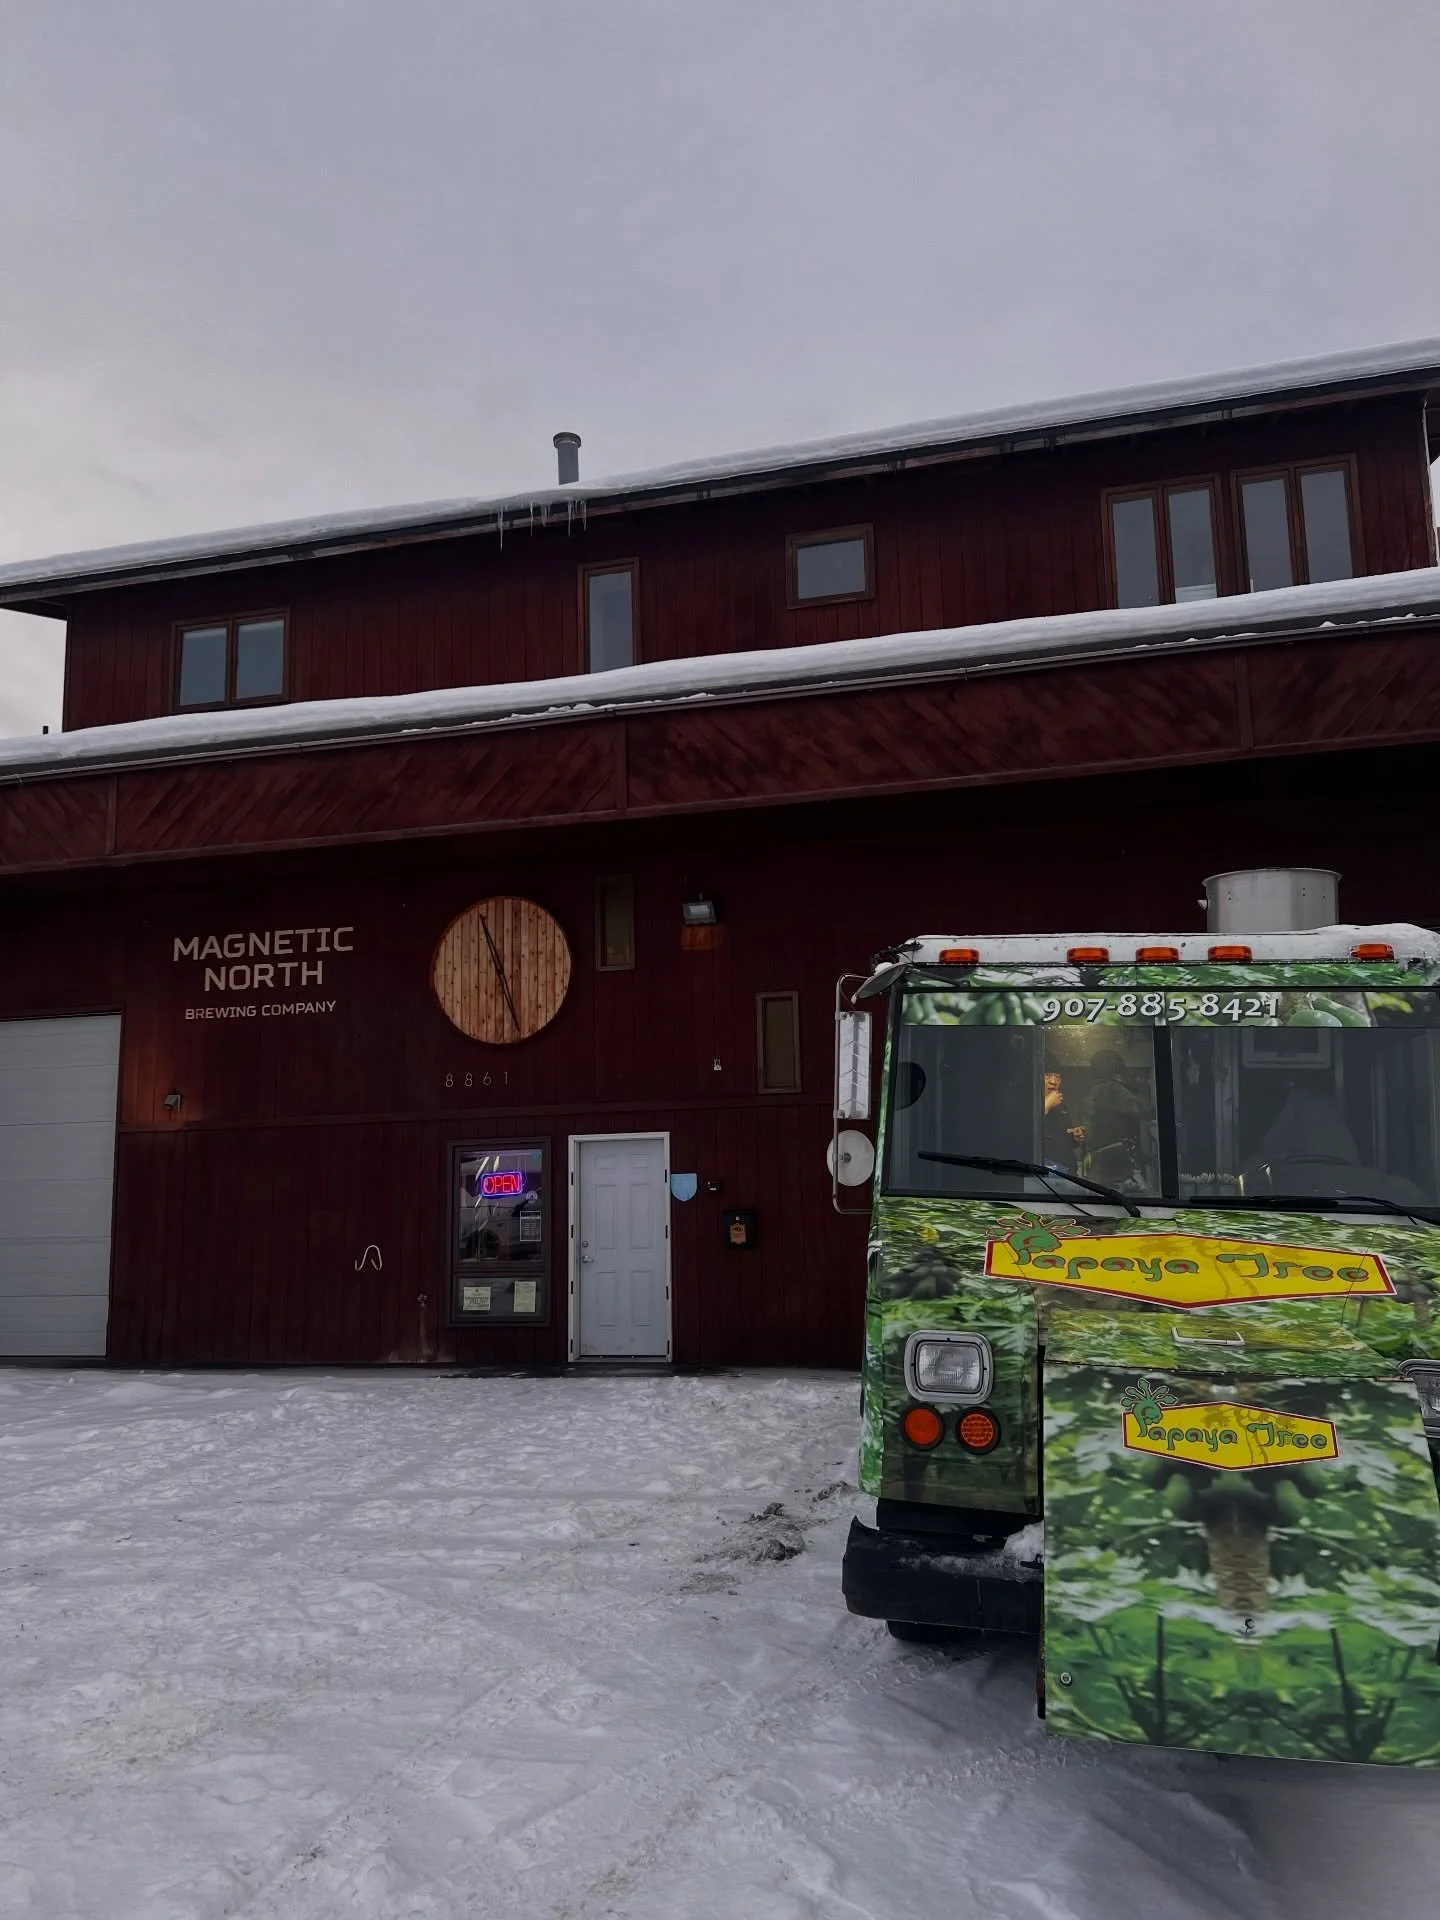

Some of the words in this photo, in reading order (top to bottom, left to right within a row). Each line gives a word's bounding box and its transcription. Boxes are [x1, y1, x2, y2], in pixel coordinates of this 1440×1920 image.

[173, 926, 354, 962] MAGNETIC
[204, 960, 323, 992] NORTH
[185, 1005, 257, 1020] BREWING
[261, 1000, 337, 1017] COMPANY
[1042, 993, 1279, 1023] 907-885-8421
[445, 1071, 509, 1088] 8861
[483, 1174, 521, 1194] OPEN
[1005, 1226, 1200, 1282] Papaya
[1215, 1252, 1370, 1282] Tree
[1132, 1400, 1238, 1453] Papaya
[1246, 1422, 1328, 1450] Tree
